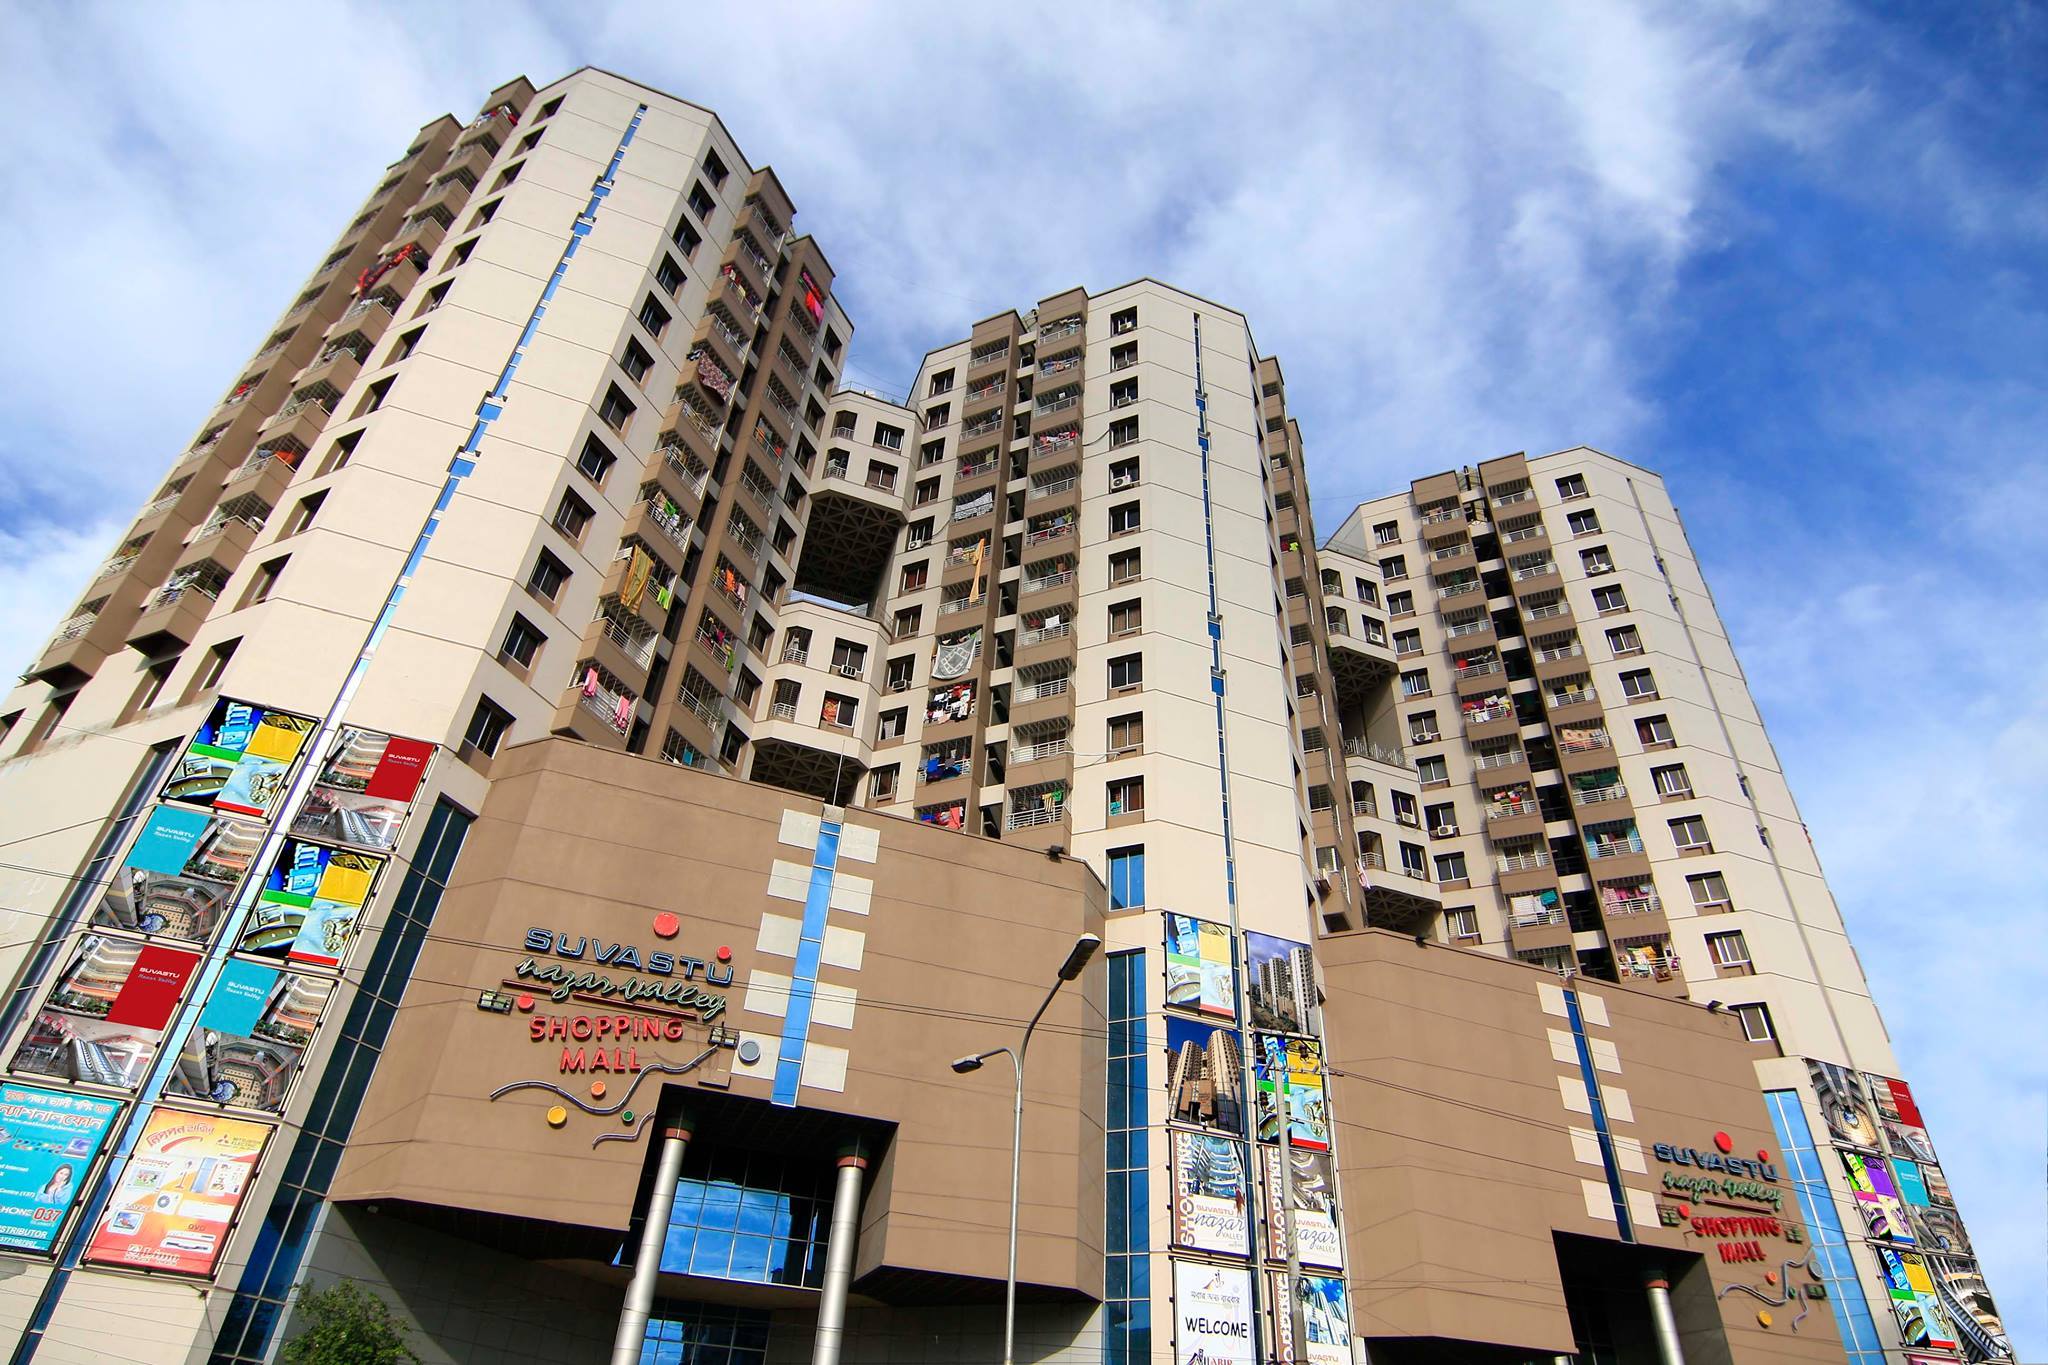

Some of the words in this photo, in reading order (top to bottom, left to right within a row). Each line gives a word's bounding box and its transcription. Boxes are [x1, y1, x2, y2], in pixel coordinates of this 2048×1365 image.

[524, 927, 734, 986] SUVASTU
[139, 967, 180, 979] SUVASTU
[615, 974, 727, 1021] valley
[529, 1015, 684, 1042] SHOPPING
[560, 1047, 642, 1074] MALL
[1653, 1143, 1779, 1181] SUVASTU
[33, 1207, 62, 1222] 037
[1196, 1203, 1234, 1215] SUVASTU
[0, 1225, 48, 1239] STRIBUTOR
[1194, 1213, 1246, 1238] nazar
[1294, 1217, 1327, 1229] UVASTU
[1691, 1216, 1782, 1238] SHOPPING
[1221, 1232, 1244, 1241] VALLEY
[1717, 1241, 1767, 1263] MALL
[1185, 1317, 1248, 1338] WELCOME
[1307, 1353, 1339, 1362] UVASTU
